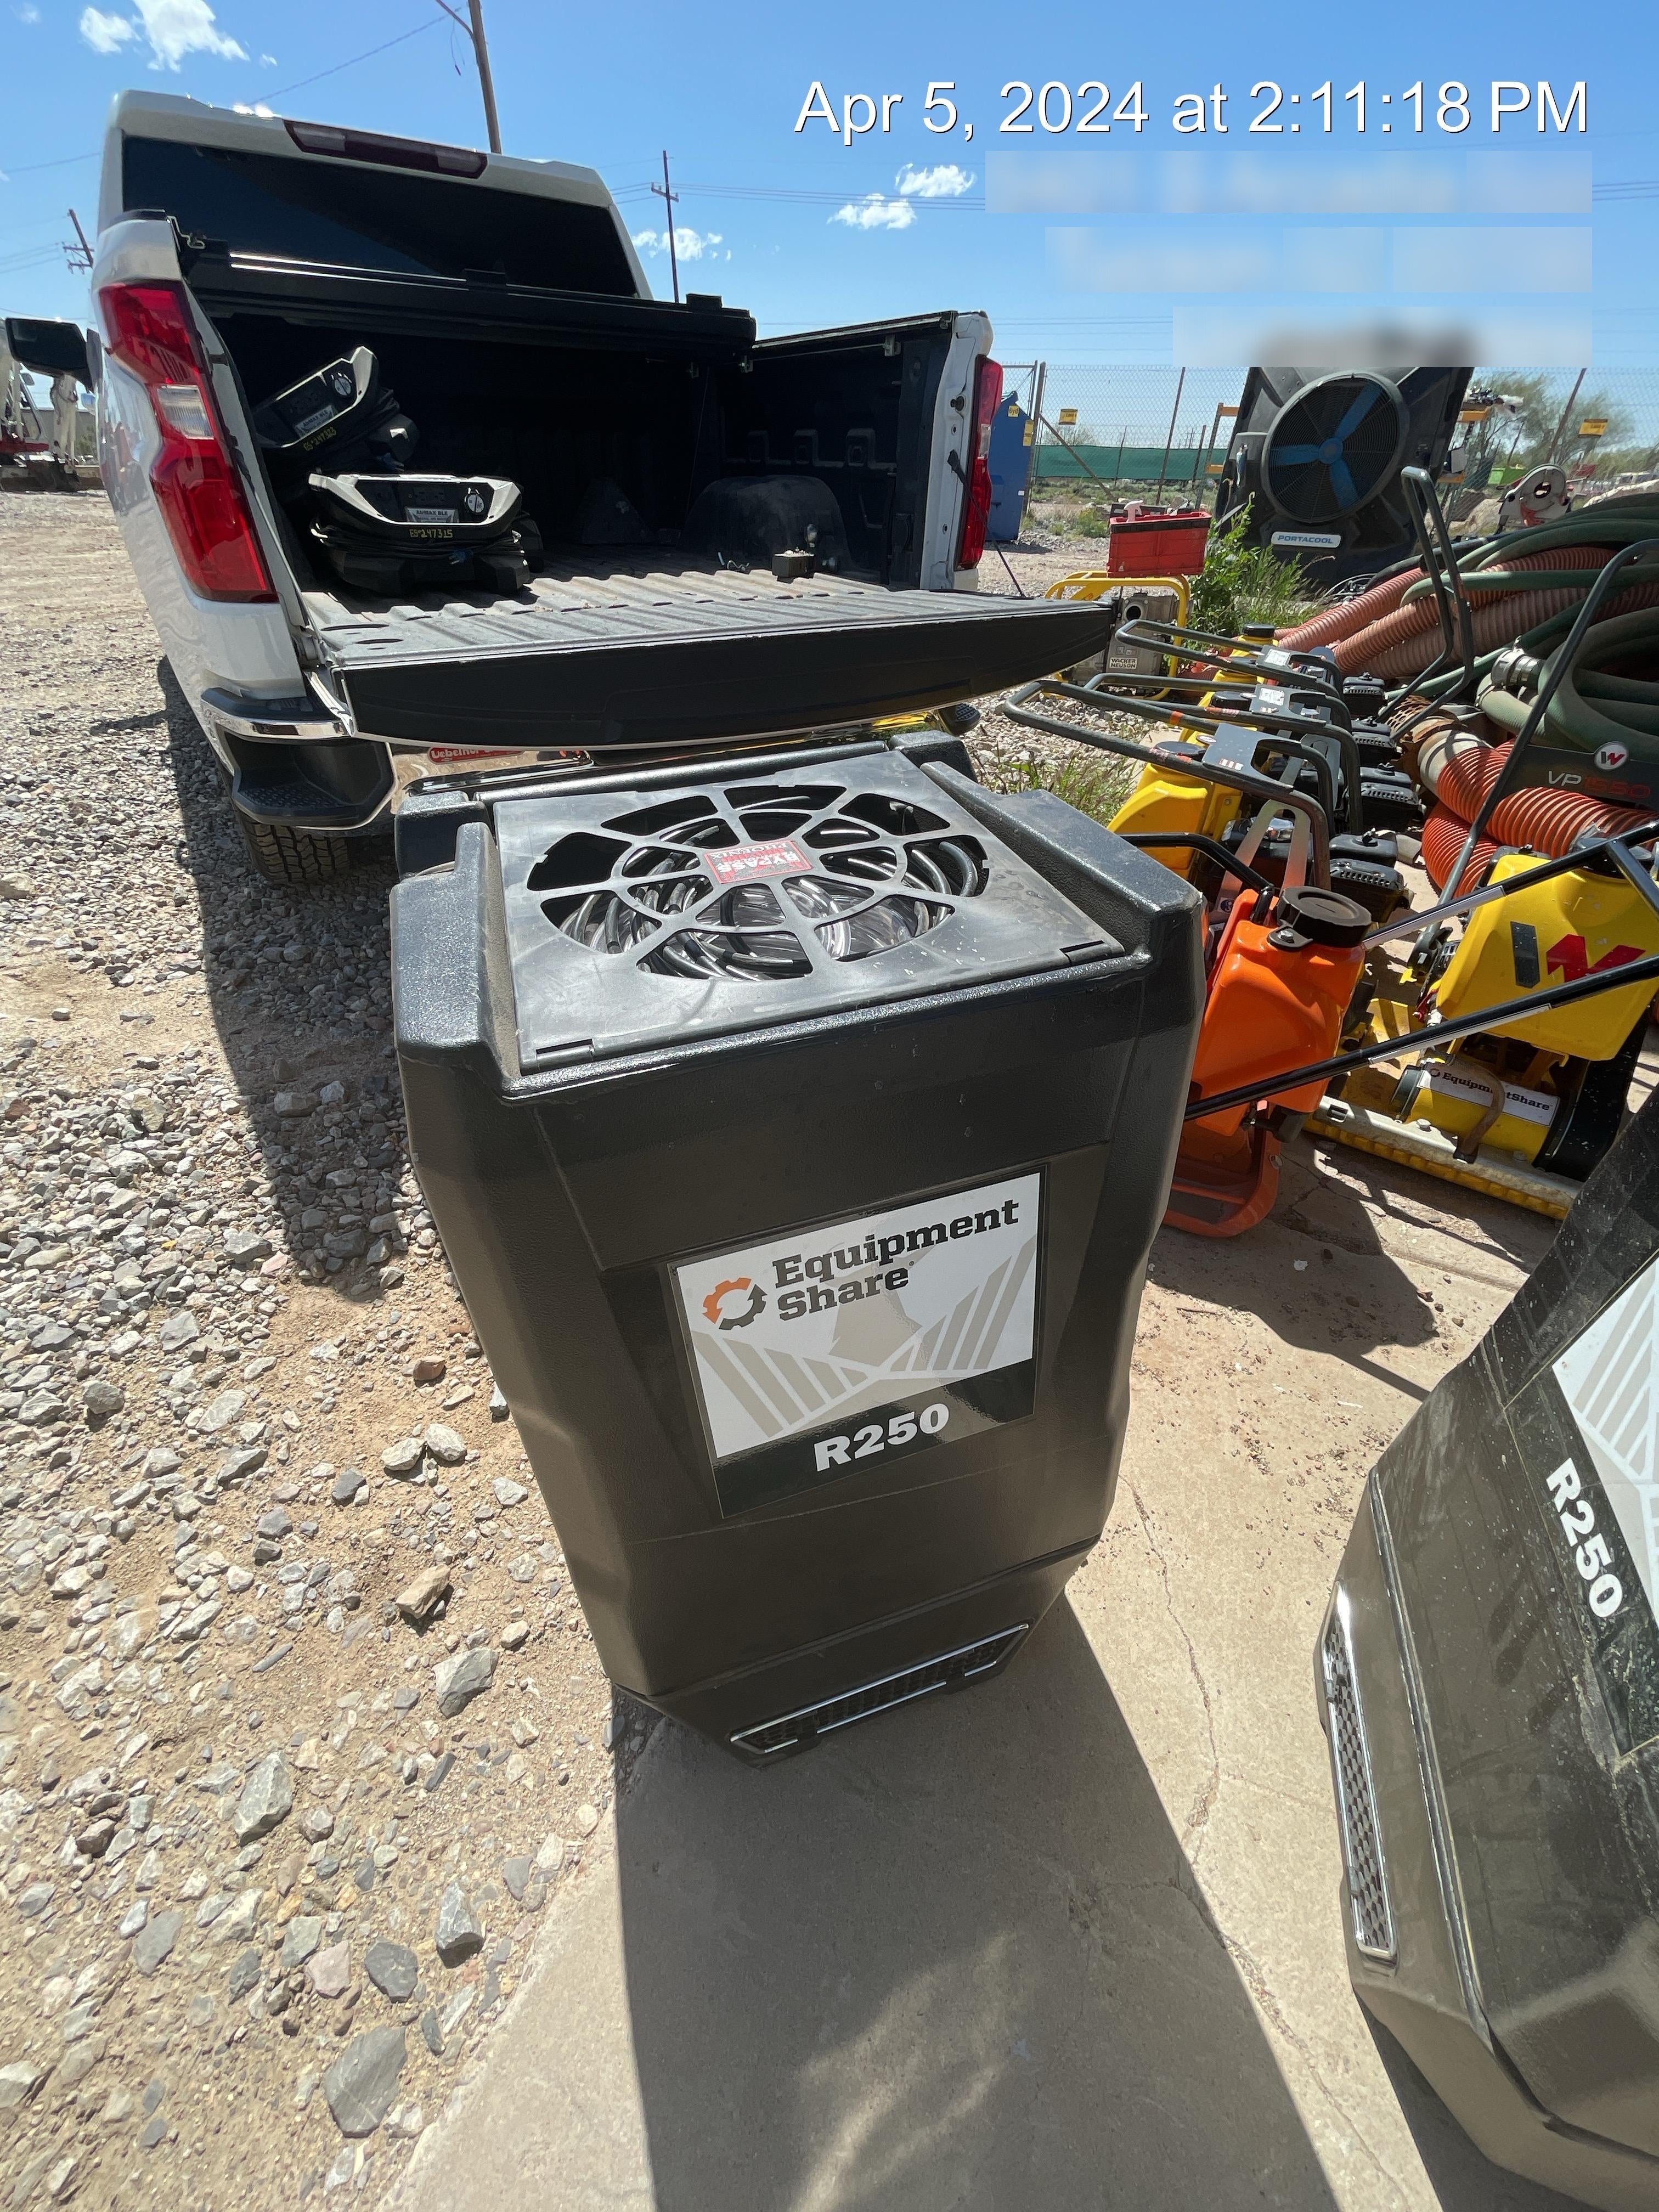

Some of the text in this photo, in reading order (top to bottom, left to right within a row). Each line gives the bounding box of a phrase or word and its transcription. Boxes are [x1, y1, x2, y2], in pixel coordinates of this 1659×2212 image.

[1278, 535, 1334, 544] PORTACOOL
[716, 852, 801, 873] BYPASS
[1442, 1071, 1550, 1110] EquipmtShare
[772, 1199, 1019, 1289] Equipment
[814, 1403, 950, 1472] R250
[1546, 1457, 1623, 1617] R250
